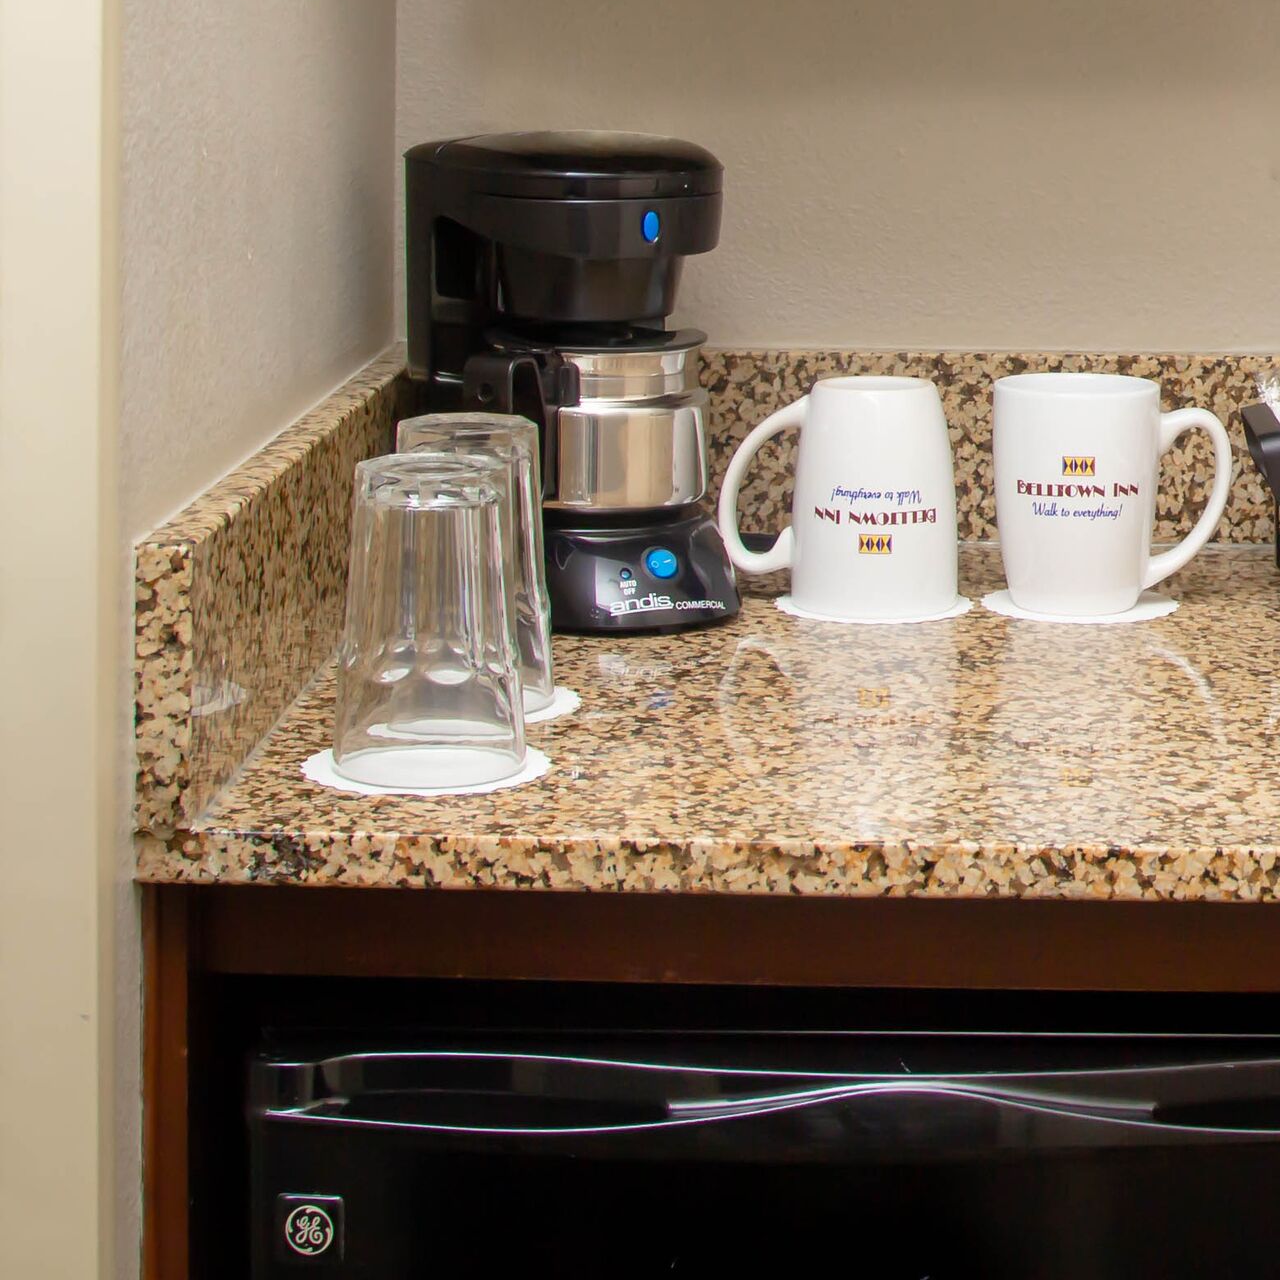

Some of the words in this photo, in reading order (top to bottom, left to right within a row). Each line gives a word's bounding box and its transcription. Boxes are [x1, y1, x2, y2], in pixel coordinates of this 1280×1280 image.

[831, 485, 882, 505] everything!
[884, 490, 894, 500] to
[897, 489, 922, 505] Walk
[1016, 479, 1105, 497] BELLTOWN
[1113, 481, 1139, 497] INN
[814, 505, 840, 524] INN
[848, 507, 936, 525] BELLTOWN
[1032, 501, 1058, 517] Walk
[1061, 507, 1070, 517] to
[1073, 503, 1123, 521] everything!
[620, 580, 637, 588] AUTO
[609, 592, 672, 614] andis
[675, 600, 726, 610] COMMERCIAL
